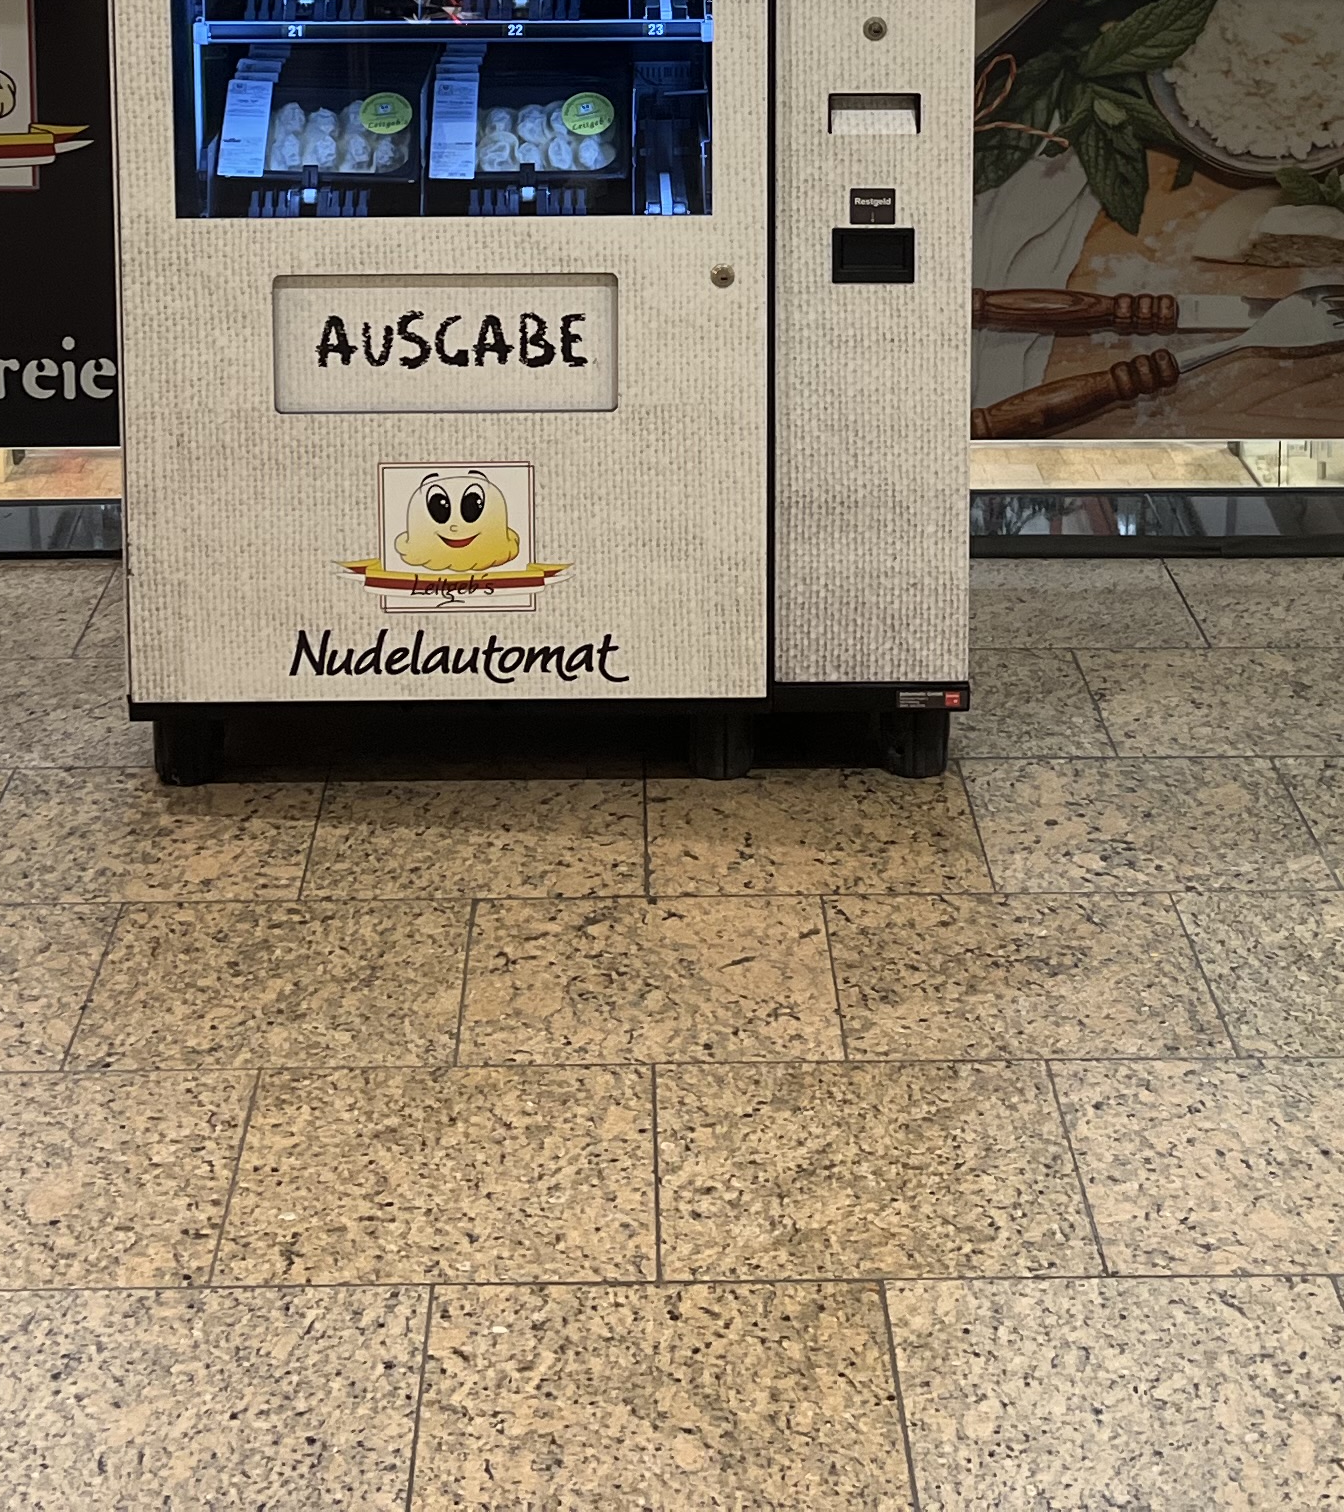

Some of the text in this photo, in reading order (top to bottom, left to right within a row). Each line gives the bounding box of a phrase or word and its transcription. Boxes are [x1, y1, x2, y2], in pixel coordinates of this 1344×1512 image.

[287, 25, 303, 37] 21
[507, 24, 524, 36] 22
[648, 24, 664, 36] 23
[854, 196, 892, 207] Restgeld
[315, 310, 589, 370] AUSGABE
[288, 629, 630, 684] Nudelautomat
